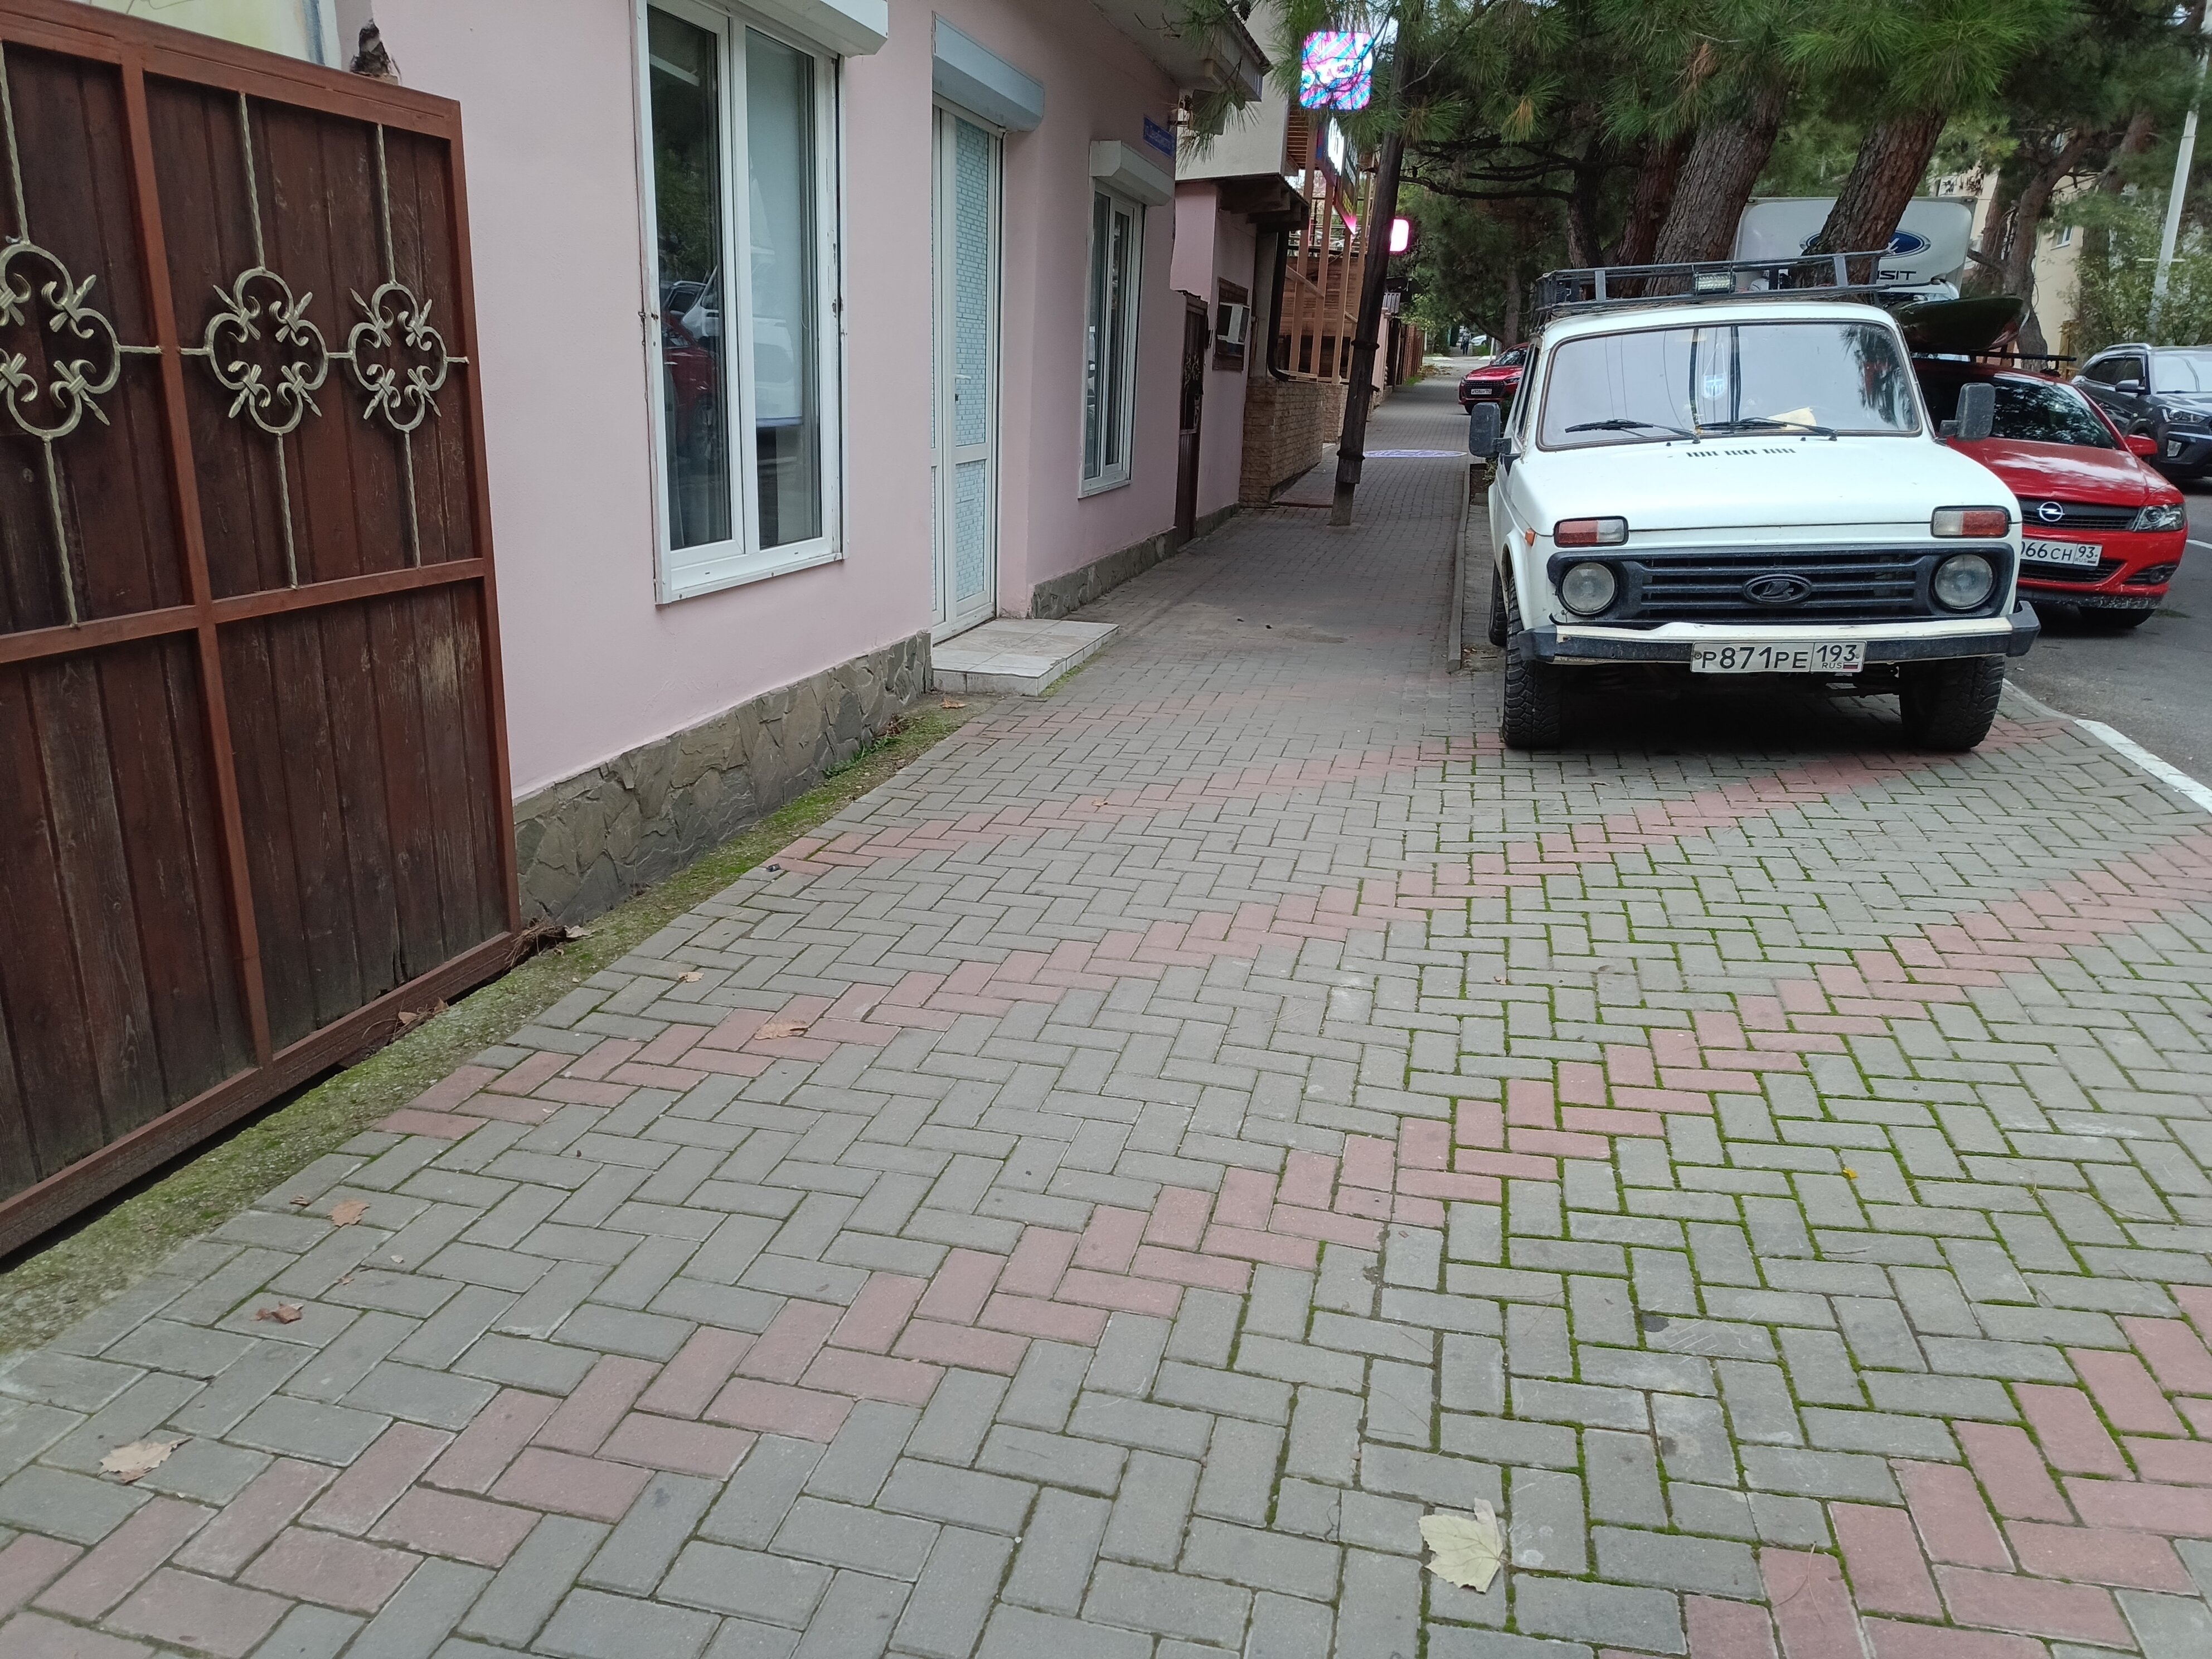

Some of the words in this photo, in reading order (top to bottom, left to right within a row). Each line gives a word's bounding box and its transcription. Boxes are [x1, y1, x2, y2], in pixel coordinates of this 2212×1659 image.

[1877, 270, 1917, 280] SIT
[2078, 546, 2095, 558] 93
[1701, 647, 1808, 669] Р871РЕ
[1816, 644, 1857, 662] 193
